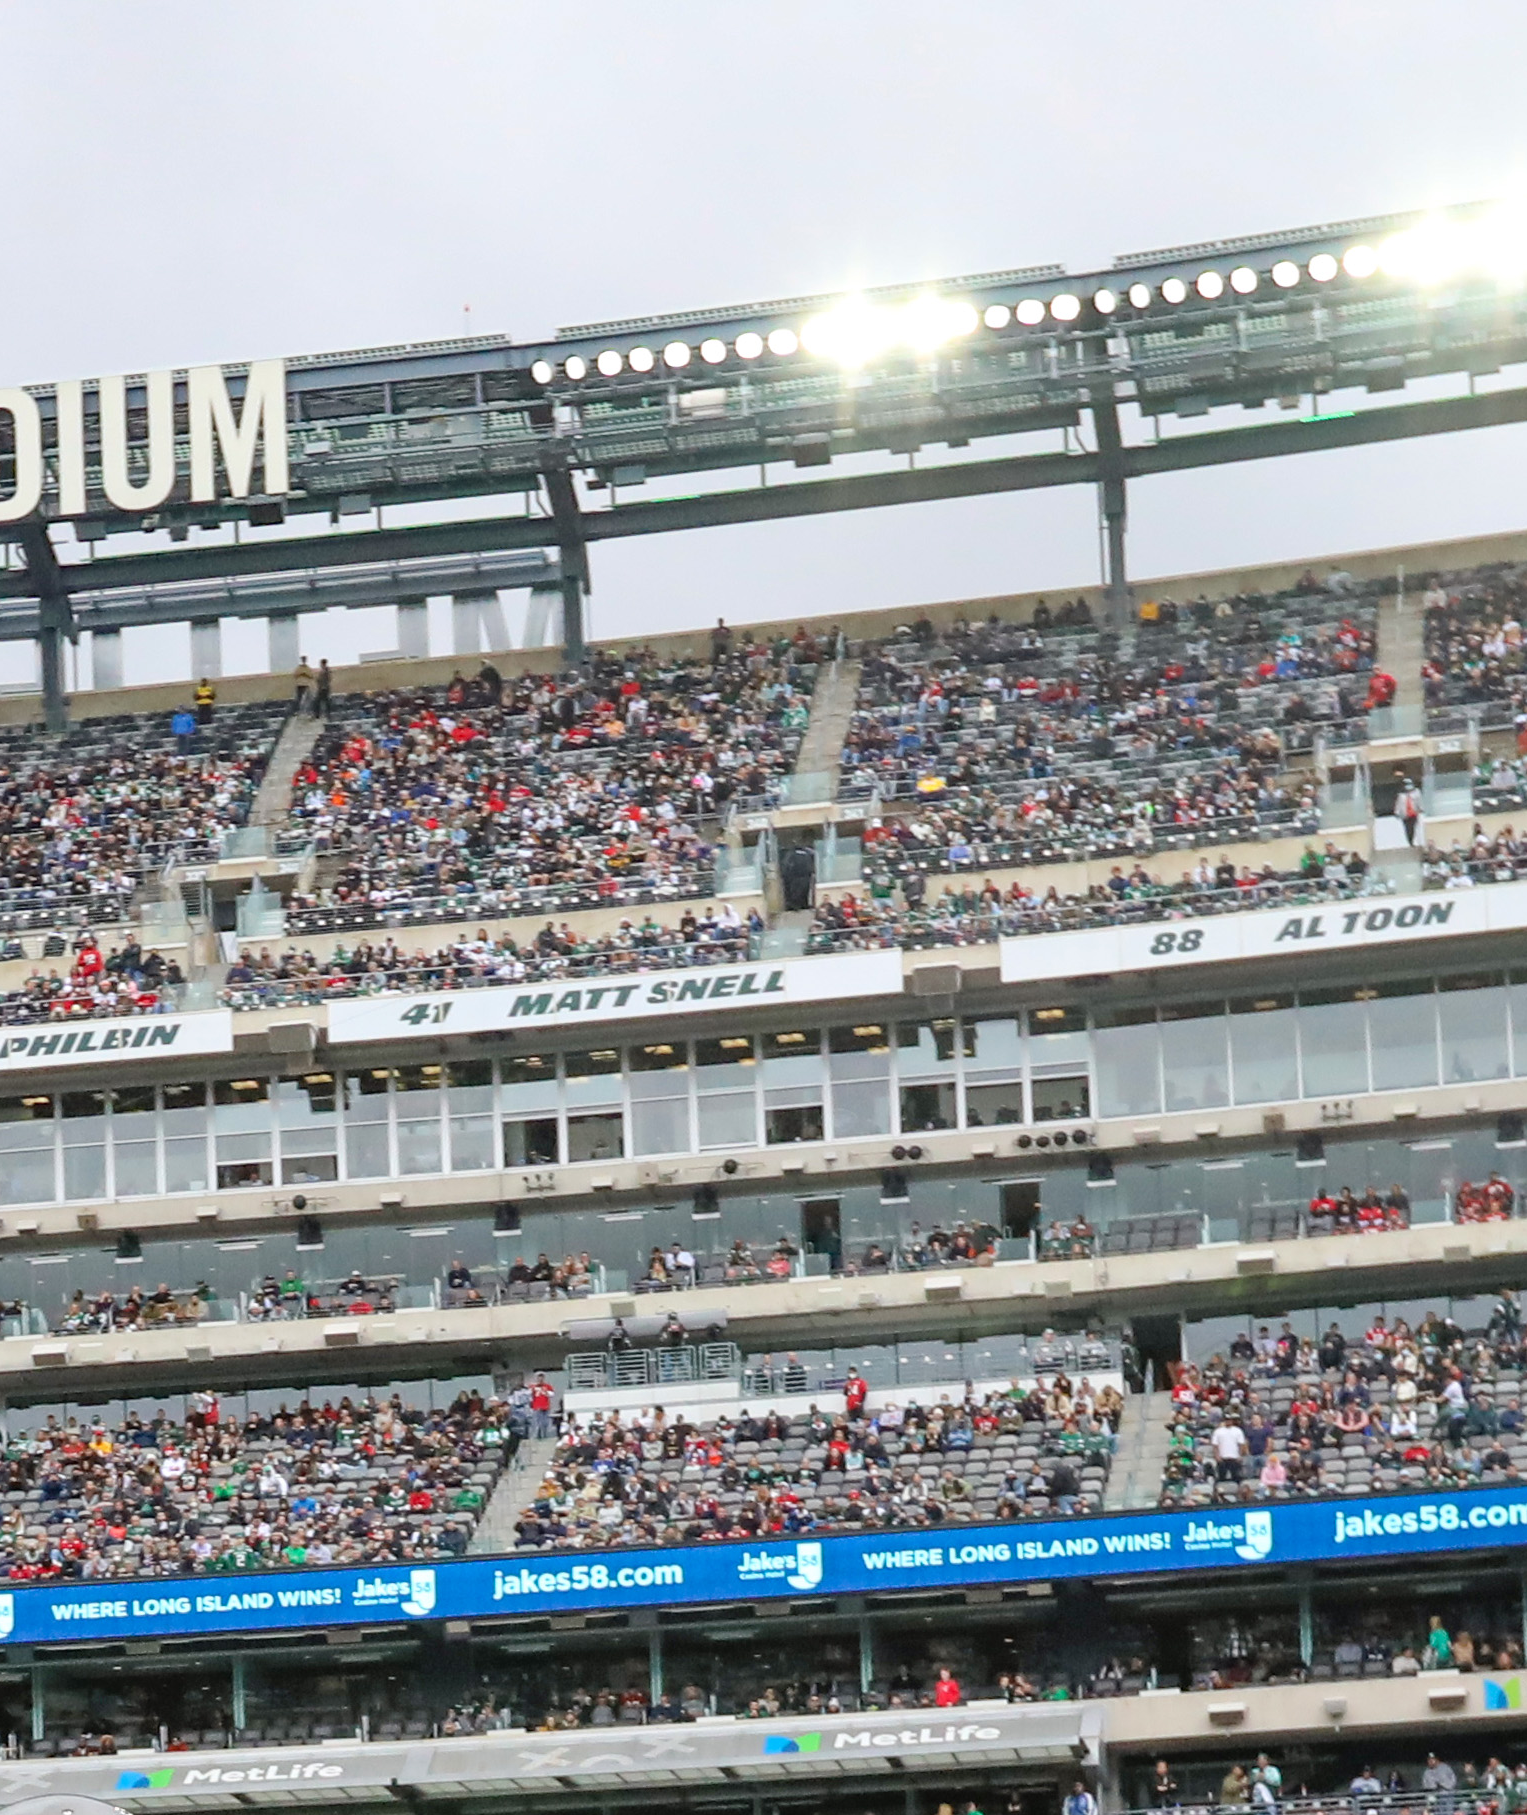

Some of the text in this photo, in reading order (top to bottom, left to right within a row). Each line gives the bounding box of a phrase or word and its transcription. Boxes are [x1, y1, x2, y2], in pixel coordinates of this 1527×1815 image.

[1149, 901, 1455, 956] 88 AL TOON
[399, 969, 786, 1026] 41 MATT SNELL
[1182, 1520, 1245, 1542] Jake's
[737, 1551, 797, 1572] Jake's
[862, 1532, 1172, 1570] WHERE LONG ISLAND WINS!
[351, 1577, 411, 1598] Jake's
[493, 1562, 684, 1601] jakes58.com
[51, 1588, 342, 1621] WHERE LONG ISLAND WINS!
[834, 1724, 1001, 1748] MetLife
[183, 1761, 344, 1785] MetLife
